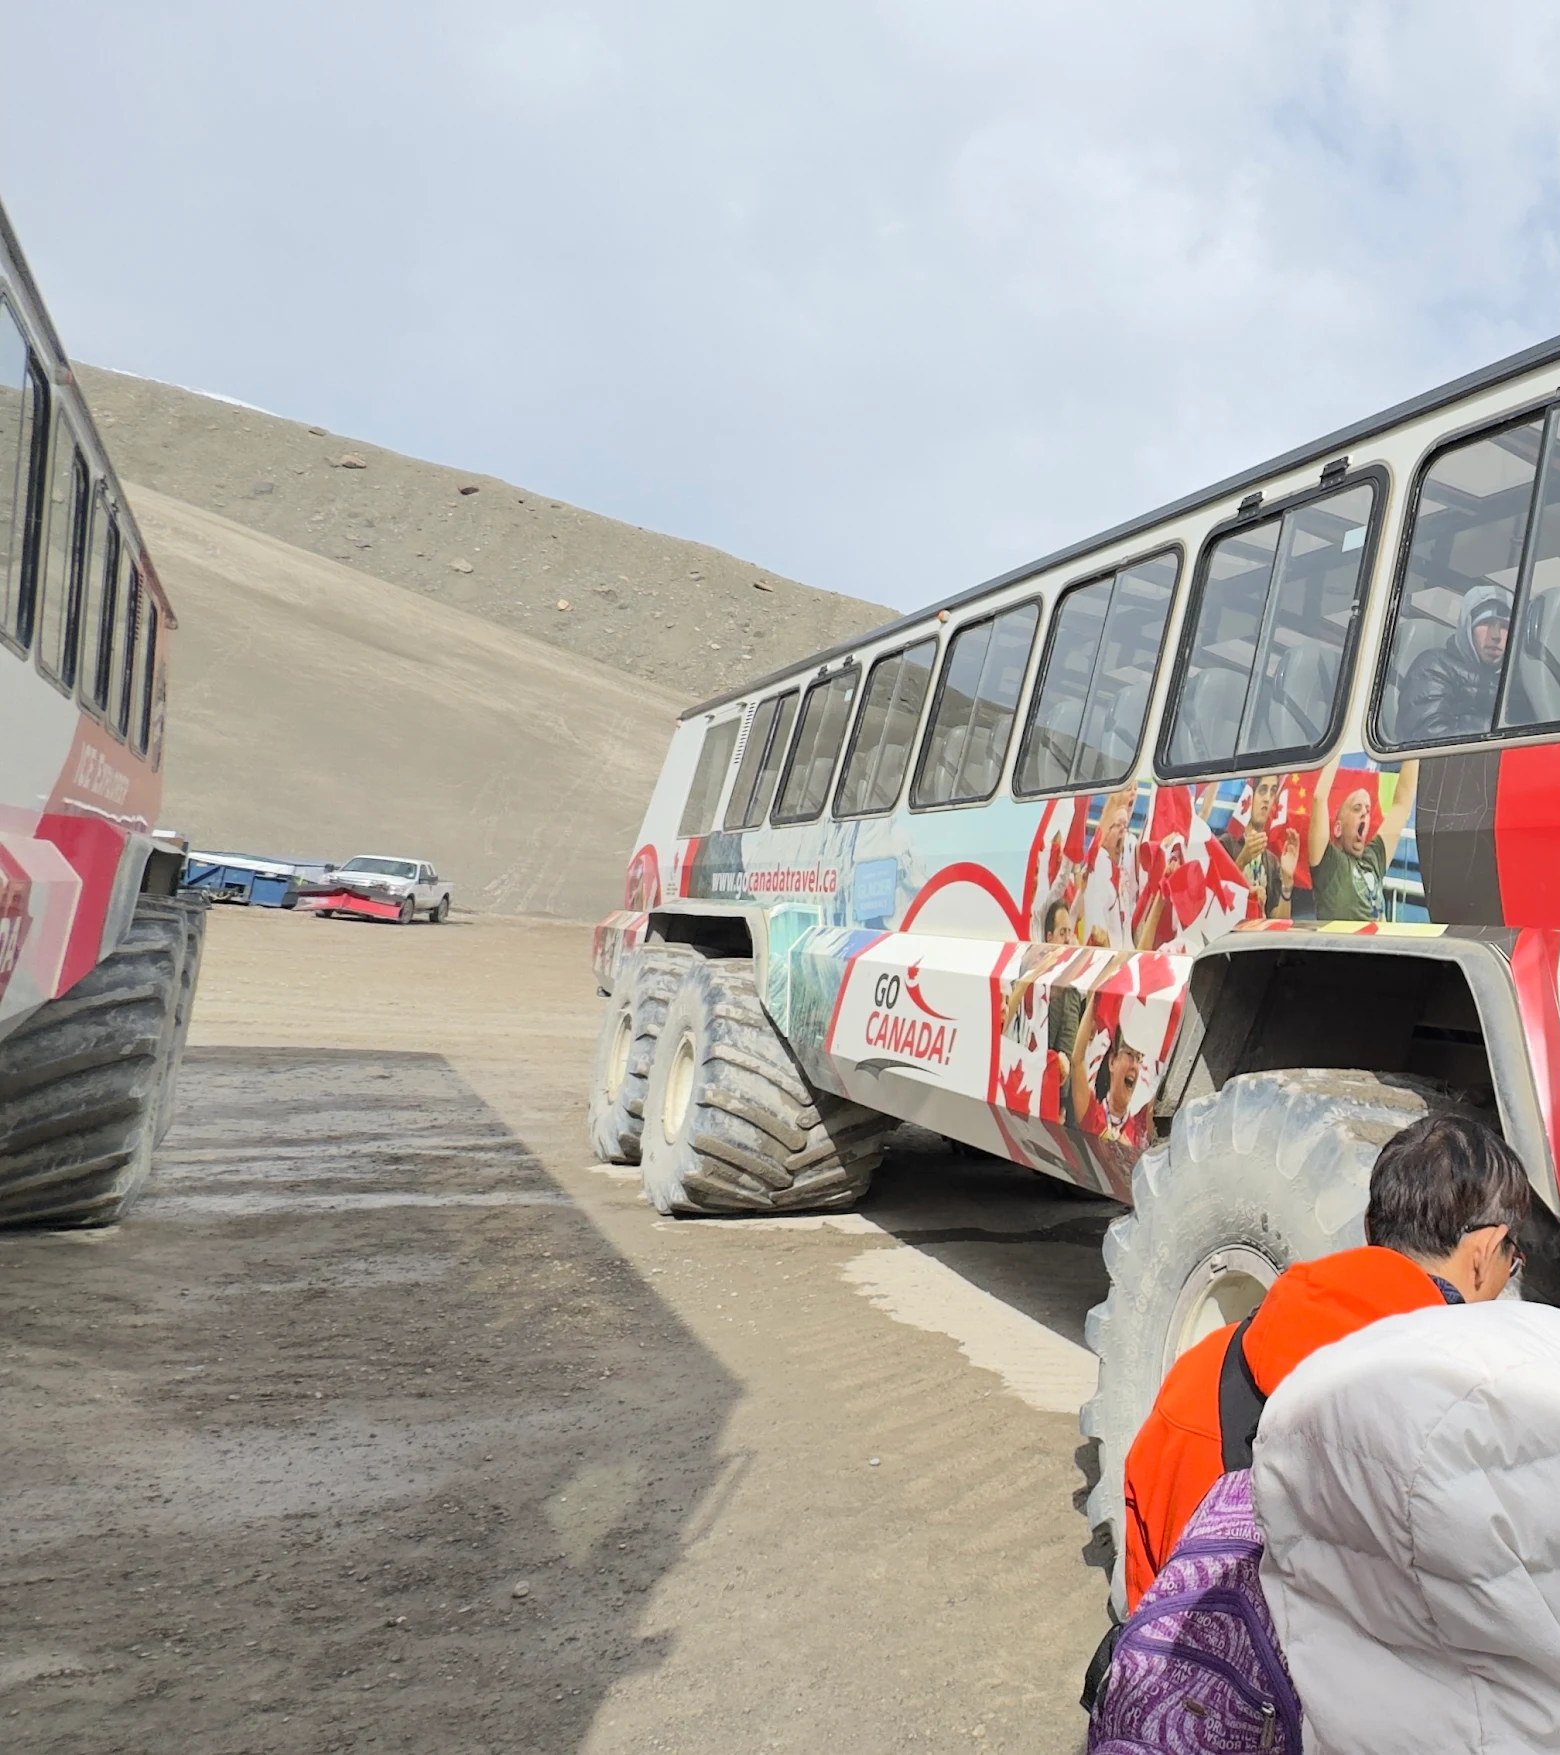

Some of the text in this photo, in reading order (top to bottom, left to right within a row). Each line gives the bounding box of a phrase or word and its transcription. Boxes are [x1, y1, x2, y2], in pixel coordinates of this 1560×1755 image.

[711, 861, 838, 899] www.gocanadatravel.ca
[874, 973, 901, 1010] GO
[865, 1010, 958, 1066] CANADA!
